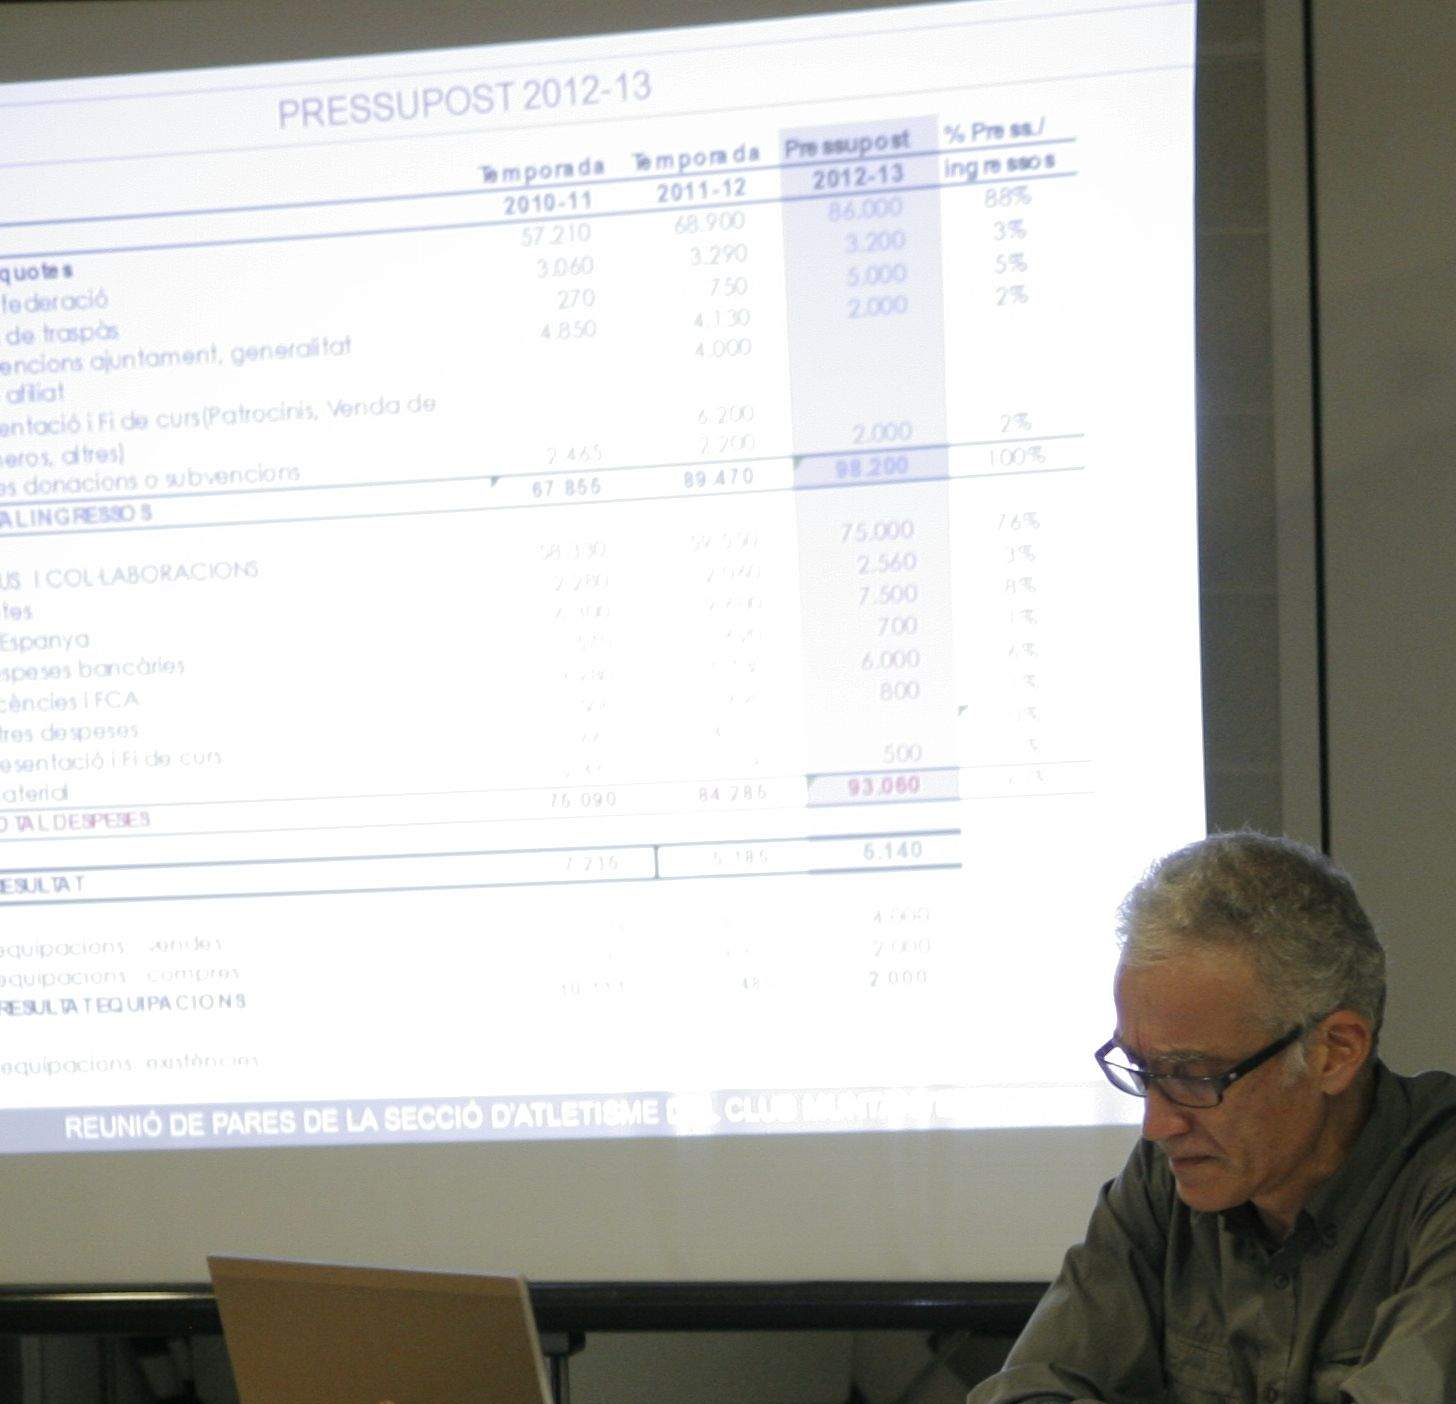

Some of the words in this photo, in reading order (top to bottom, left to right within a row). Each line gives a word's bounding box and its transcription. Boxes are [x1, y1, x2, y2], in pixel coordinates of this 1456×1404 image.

[277, 80, 514, 129] PRESSUPOST
[522, 69, 653, 110] 2012-13
[478, 157, 606, 186] Temporada
[632, 142, 761, 175] Temporada
[784, 129, 911, 159] Pressupost
[504, 190, 593, 215] 2010-11
[656, 176, 747, 203] 2011-12
[813, 162, 905, 190] 2012-13
[944, 153, 1056, 182] ingressos
[0, 262, 74, 285] quotes
[557, 288, 596, 311] 270
[6, 327, 35, 346] de
[231, 336, 353, 366] generalitat
[120, 411, 149, 431] de
[327, 396, 401, 418] Venda
[407, 394, 436, 413] de
[23, 472, 137, 495] donacions
[144, 471, 159, 489] o
[165, 463, 301, 488] subvencions
[878, 617, 918, 637] 700
[79, 655, 185, 678] bancàries
[95, 689, 140, 708] FCA
[879, 680, 921, 700] 800
[41, 721, 139, 742] despeses
[144, 749, 171, 768] de
[883, 743, 923, 764] 500
[65, 1109, 162, 1140] REUNIÓ
[170, 1113, 204, 1137] DE
[211, 1110, 296, 1135] PARES
[304, 1108, 340, 1133] DE
[346, 1107, 380, 1133] LA
[384, 1098, 483, 1131] SECCIÓ
[491, 1097, 660, 1131] D'ATLETISME
